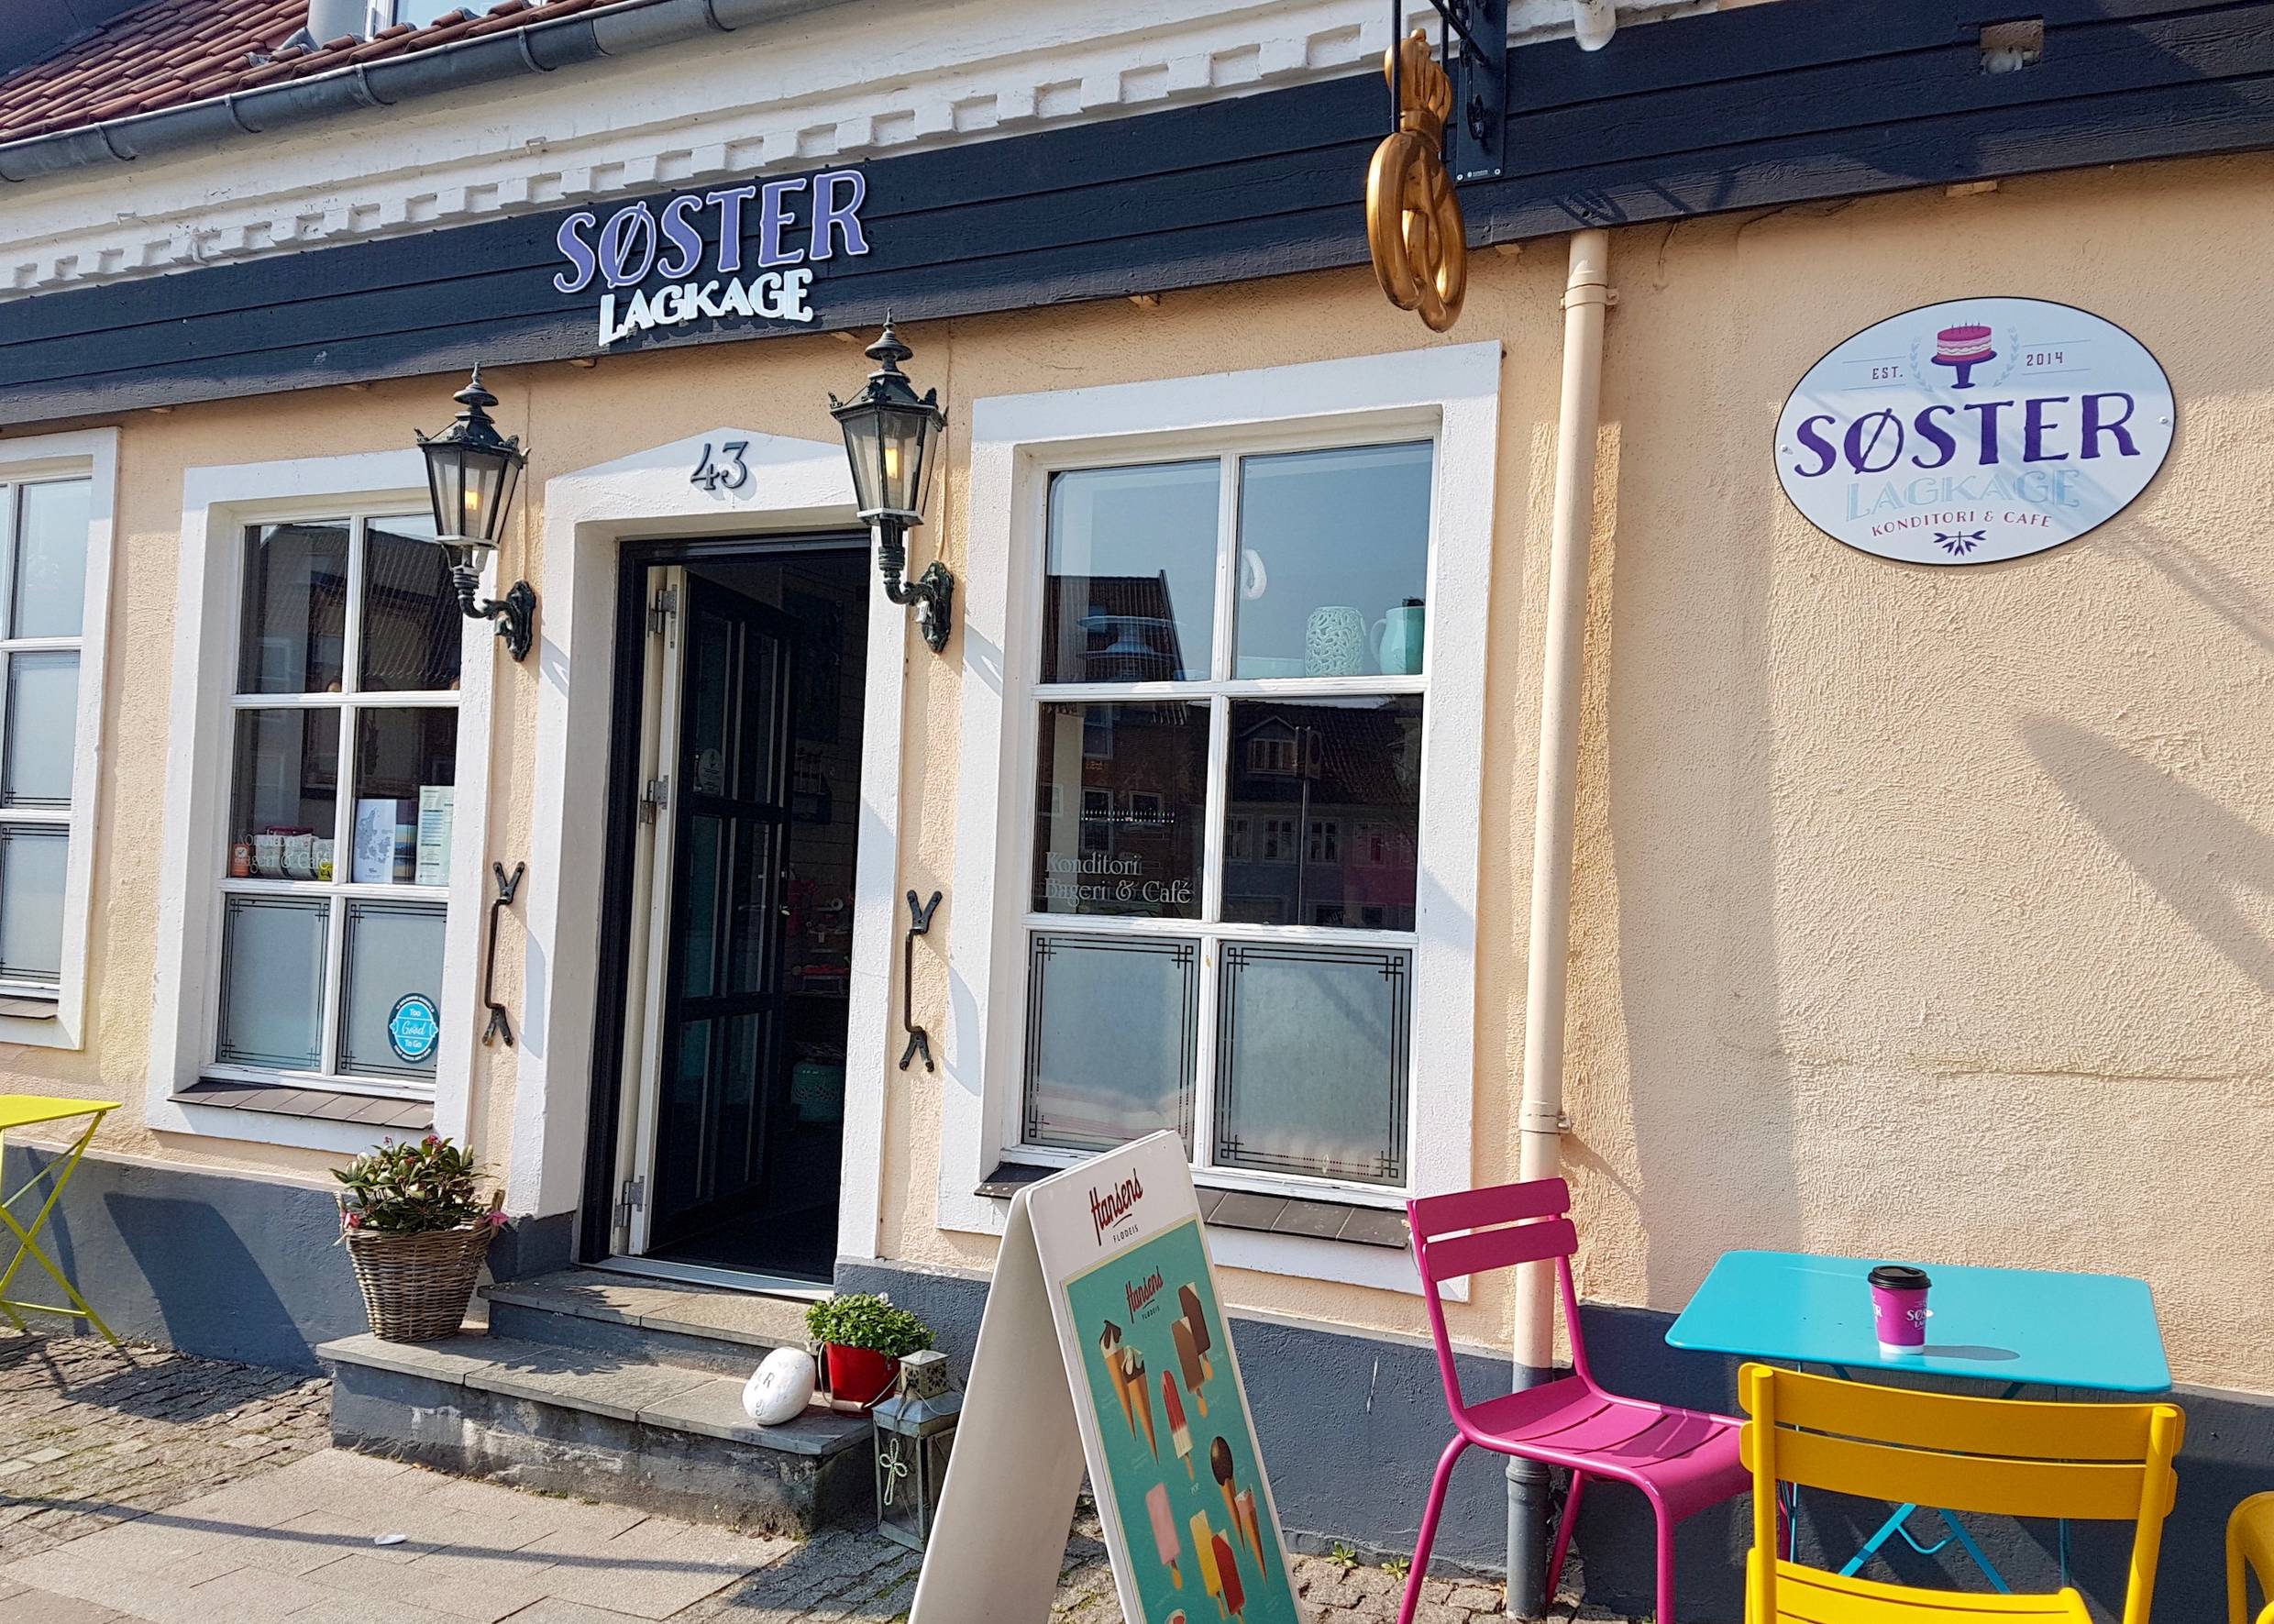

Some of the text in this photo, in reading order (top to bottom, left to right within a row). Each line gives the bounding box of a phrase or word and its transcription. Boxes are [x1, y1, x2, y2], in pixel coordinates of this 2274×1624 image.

[554, 170, 869, 293] SØSTER
[599, 269, 813, 346] LAGKAGE
[1871, 351, 2064, 381] EST. 2014
[1794, 392, 2141, 478] SØSTER
[690, 441, 749, 491] 43
[1846, 469, 2081, 522] LAGKAGE
[1871, 511, 2053, 536] KONDITORI & CAFE
[1045, 851, 1139, 876] Konditori
[1115, 879, 1134, 901] &
[1143, 879, 1192, 904] Café
[402, 1020, 427, 1035] Good
[410, 1008, 422, 1017] Too
[404, 1039, 422, 1048] To Go
[1089, 1167, 1143, 1247] Hansens
[1126, 1265, 1164, 1325] Hansens
